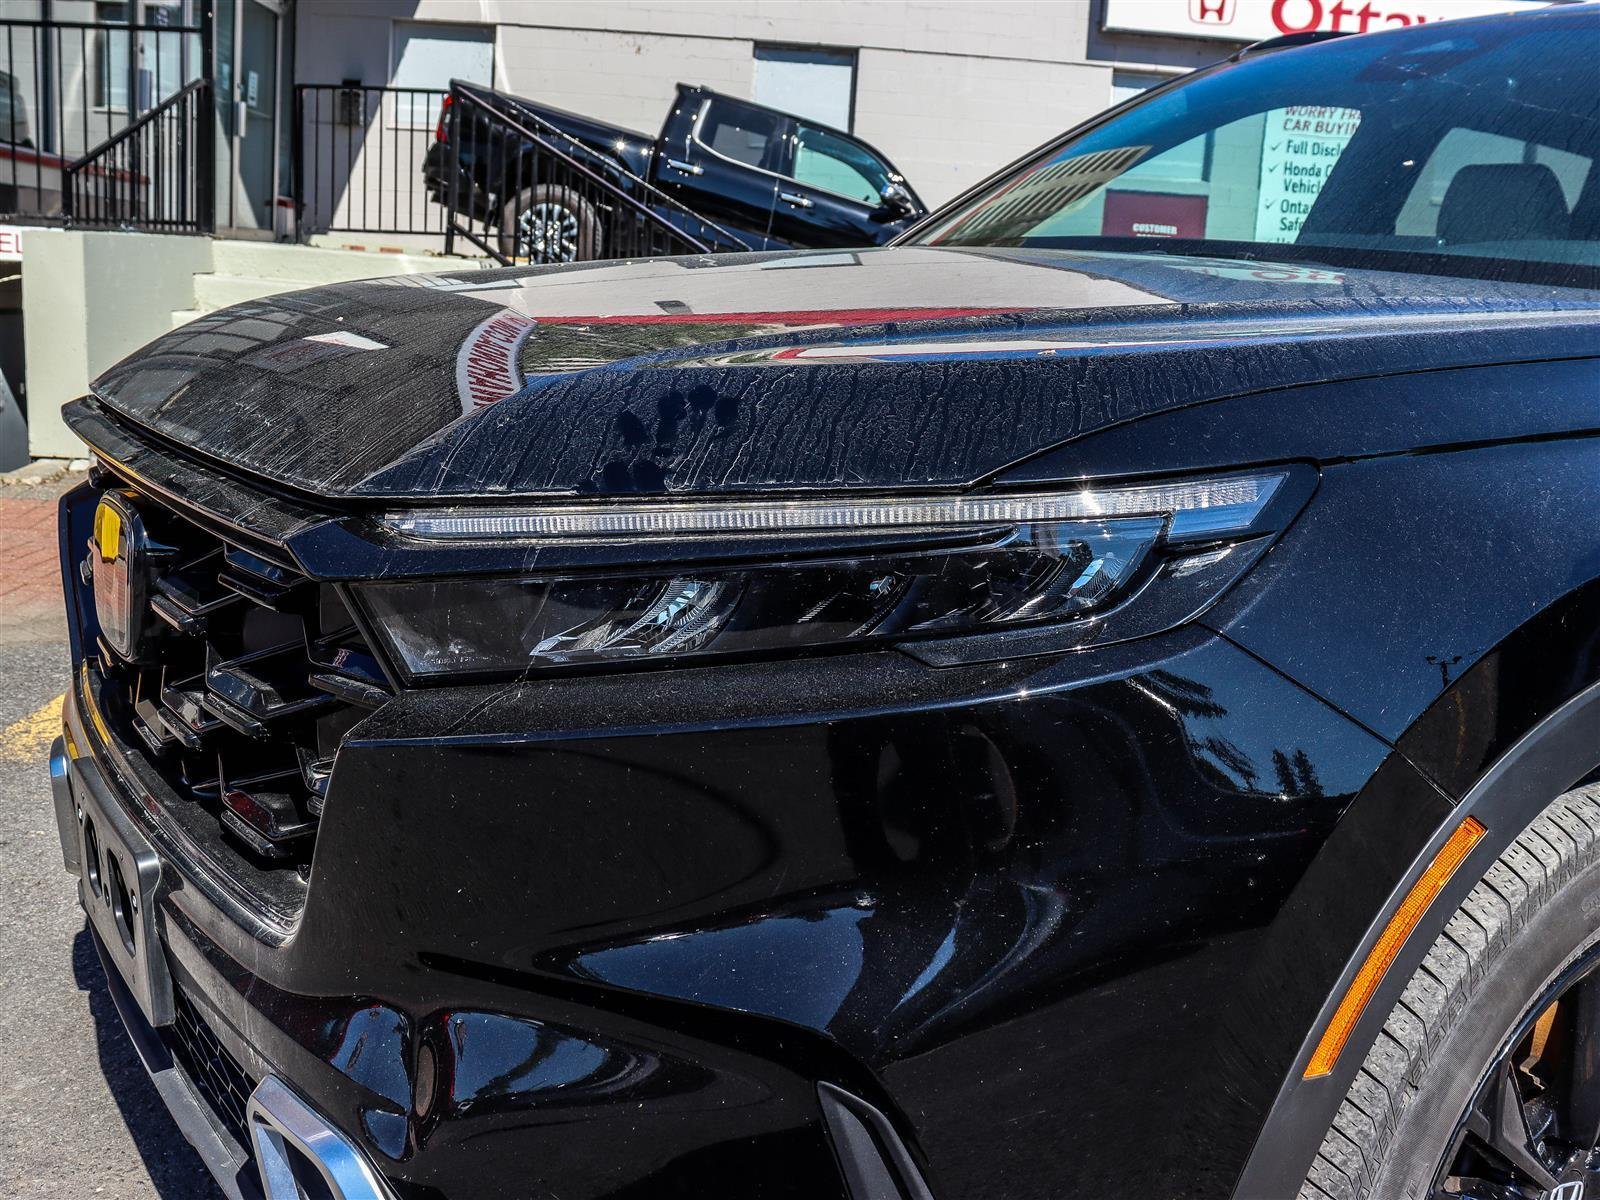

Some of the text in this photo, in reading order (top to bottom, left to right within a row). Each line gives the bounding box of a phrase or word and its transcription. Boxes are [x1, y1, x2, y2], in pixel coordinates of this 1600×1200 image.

[1285, 106, 1336, 119] WORRY
[1283, 119, 1312, 131] CAR
[1286, 140, 1308, 155] Full
[1284, 161, 1321, 177] Honda
[1132, 223, 1178, 235] CUSTOMER
